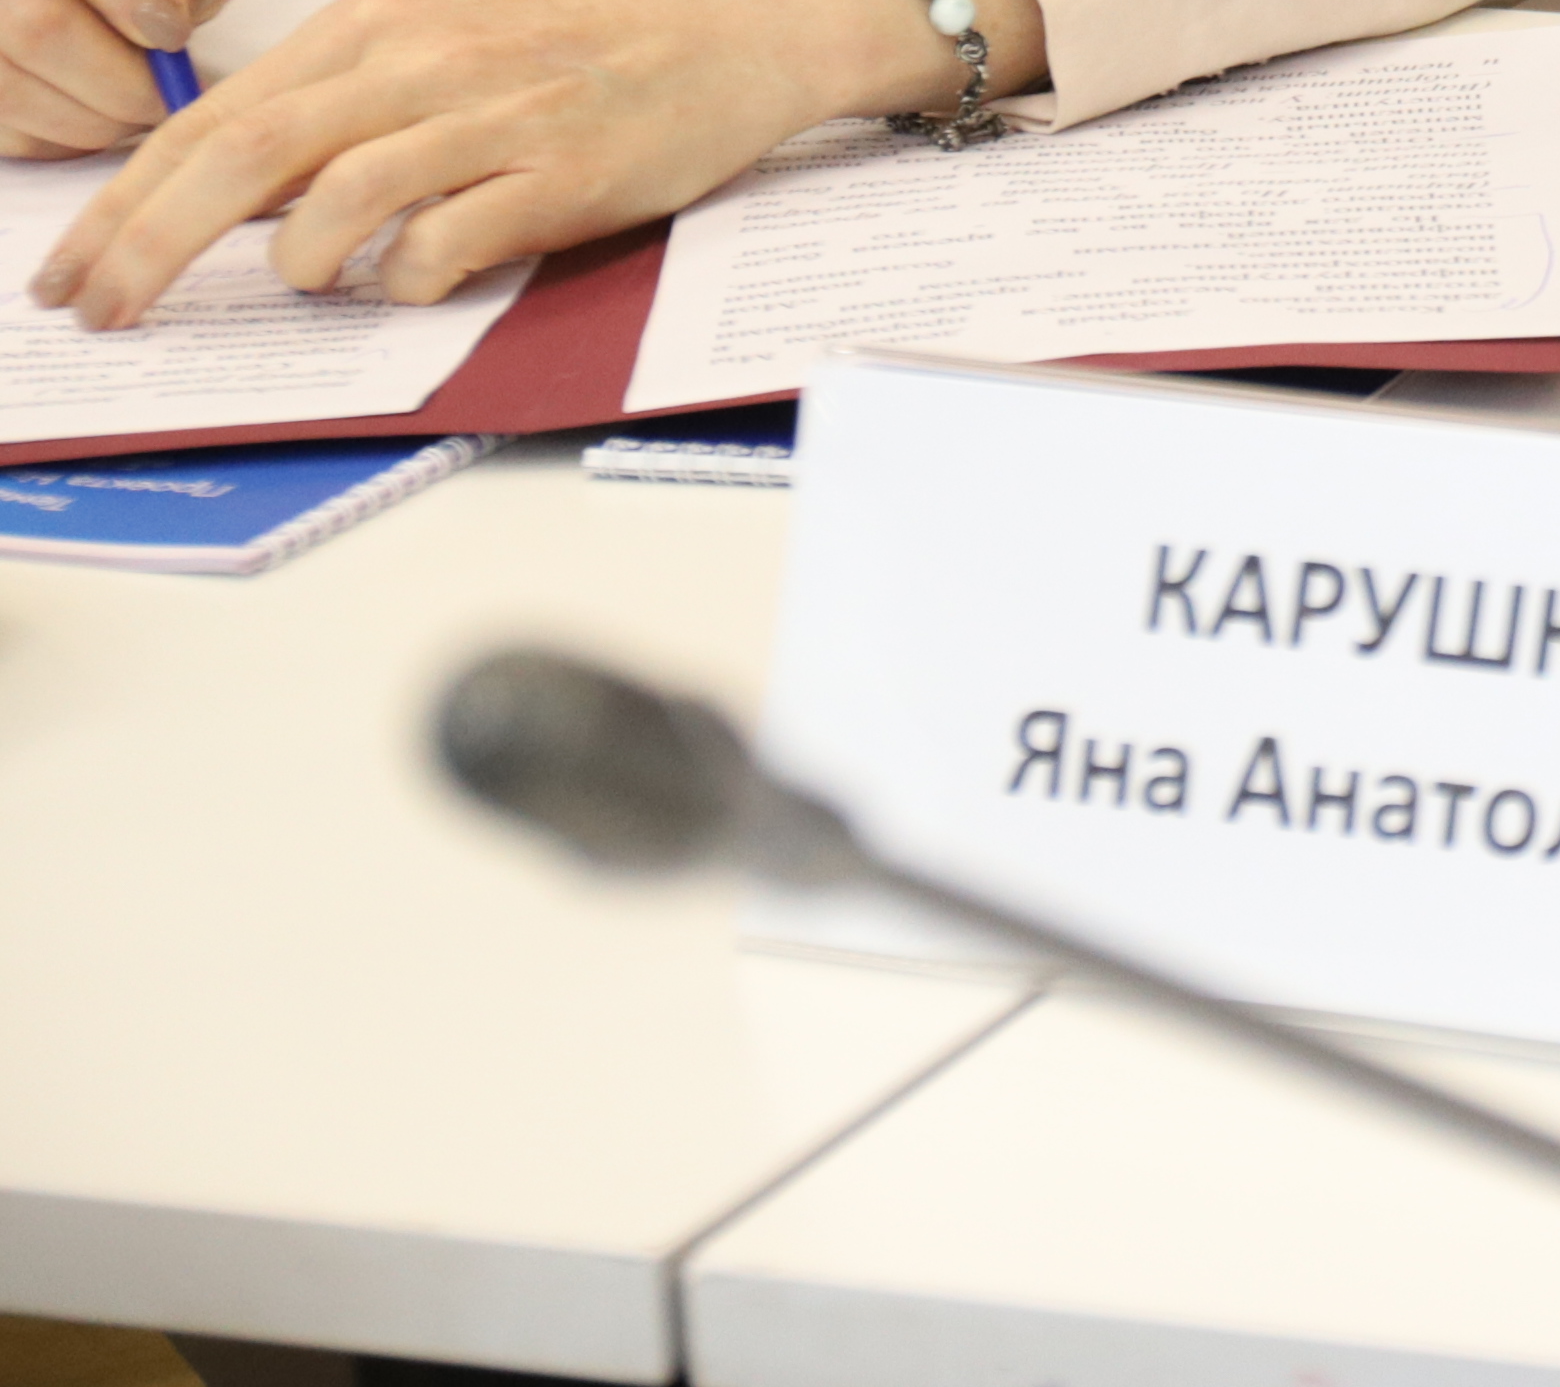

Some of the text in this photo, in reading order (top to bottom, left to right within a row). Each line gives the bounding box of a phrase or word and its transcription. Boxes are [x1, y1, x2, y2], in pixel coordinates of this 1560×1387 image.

[1321, 192, 1491, 203] здорового
[1032, 210, 1278, 225] профилактика
[1180, 219, 1273, 228] врача
[1393, 215, 1440, 223] Но
[1072, 233, 1496, 255] высокотехнологичными
[1183, 256, 1498, 270] здравоохранении,
[918, 271, 1087, 291] проектом
[1131, 268, 1498, 284] инфраструктурными
[722, 281, 864, 304] новыми
[1314, 280, 1502, 293] столичной
[839, 286, 1030, 313] проектами
[1239, 292, 1502, 303] действительно
[1021, 299, 1188, 316] гордимся
[715, 304, 972, 341] масштабными
[1058, 309, 1194, 327] добрый
[784, 317, 966, 345] прорывом
[709, 353, 775, 365] Мы
[1005, 708, 1195, 821] Яна
